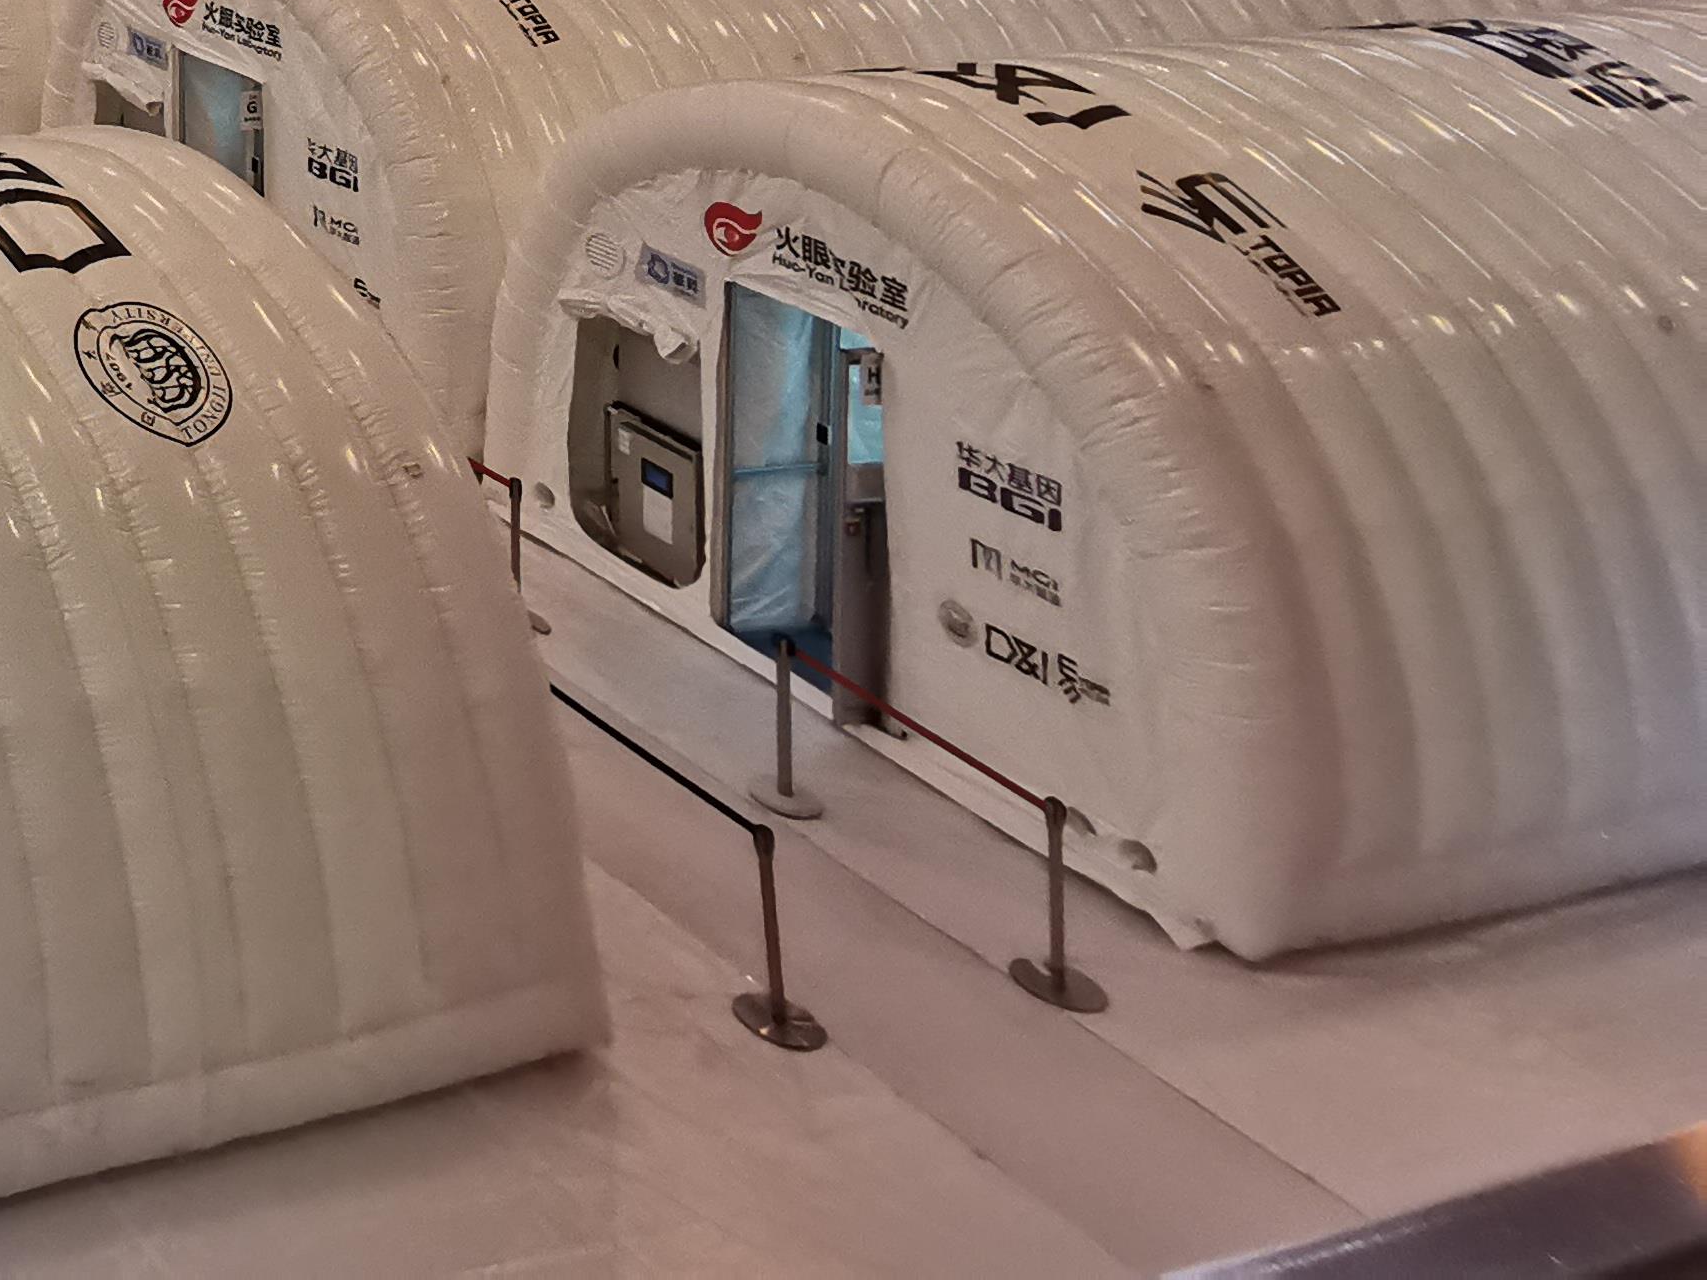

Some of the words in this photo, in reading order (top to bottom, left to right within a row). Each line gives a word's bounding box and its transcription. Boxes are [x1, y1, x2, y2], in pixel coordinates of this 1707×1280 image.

[246, 101, 258, 114] G
[307, 156, 360, 193] BGI
[955, 441, 1063, 507] 华大基因
[957, 466, 1063, 532] BGI
